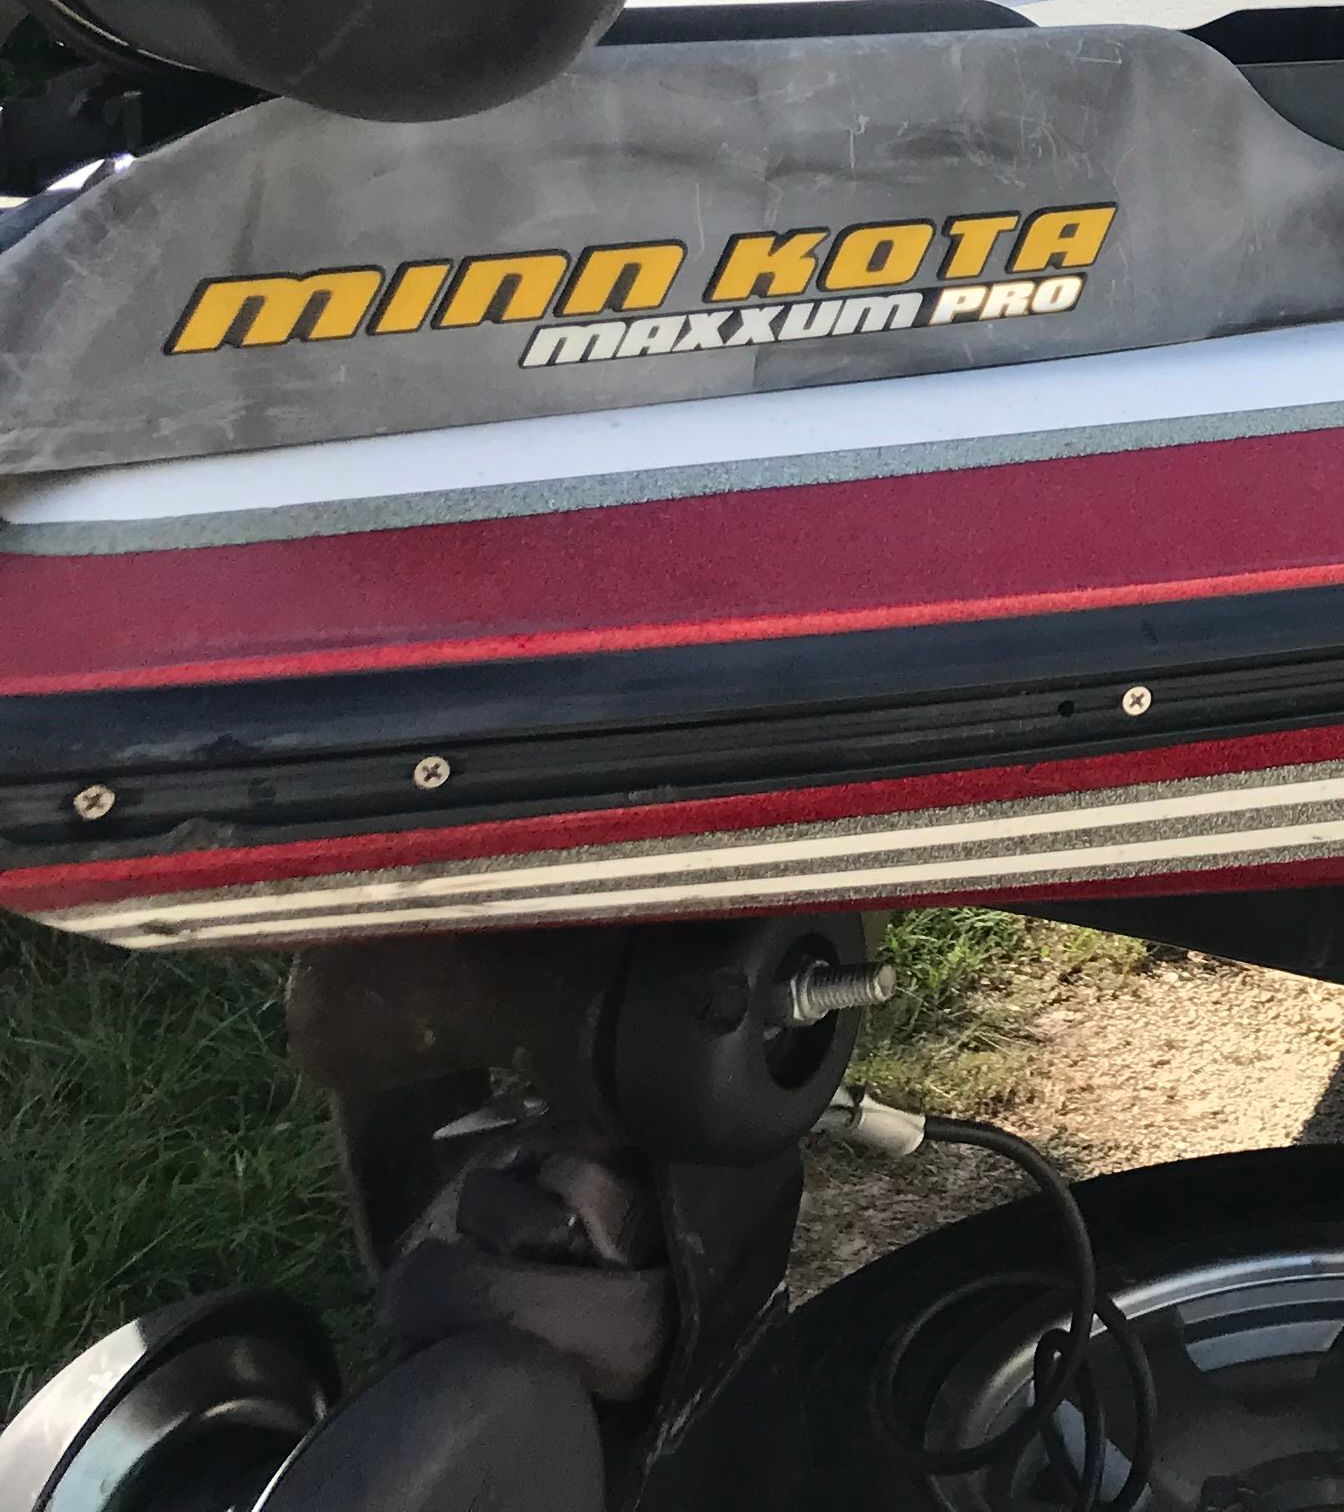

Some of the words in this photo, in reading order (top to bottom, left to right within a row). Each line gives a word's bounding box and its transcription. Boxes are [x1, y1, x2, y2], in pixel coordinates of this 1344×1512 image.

[164, 239, 687, 355] MINN
[702, 202, 1118, 303] KOTA
[519, 291, 923, 369] MAXXUM
[929, 273, 1087, 325] PRO
